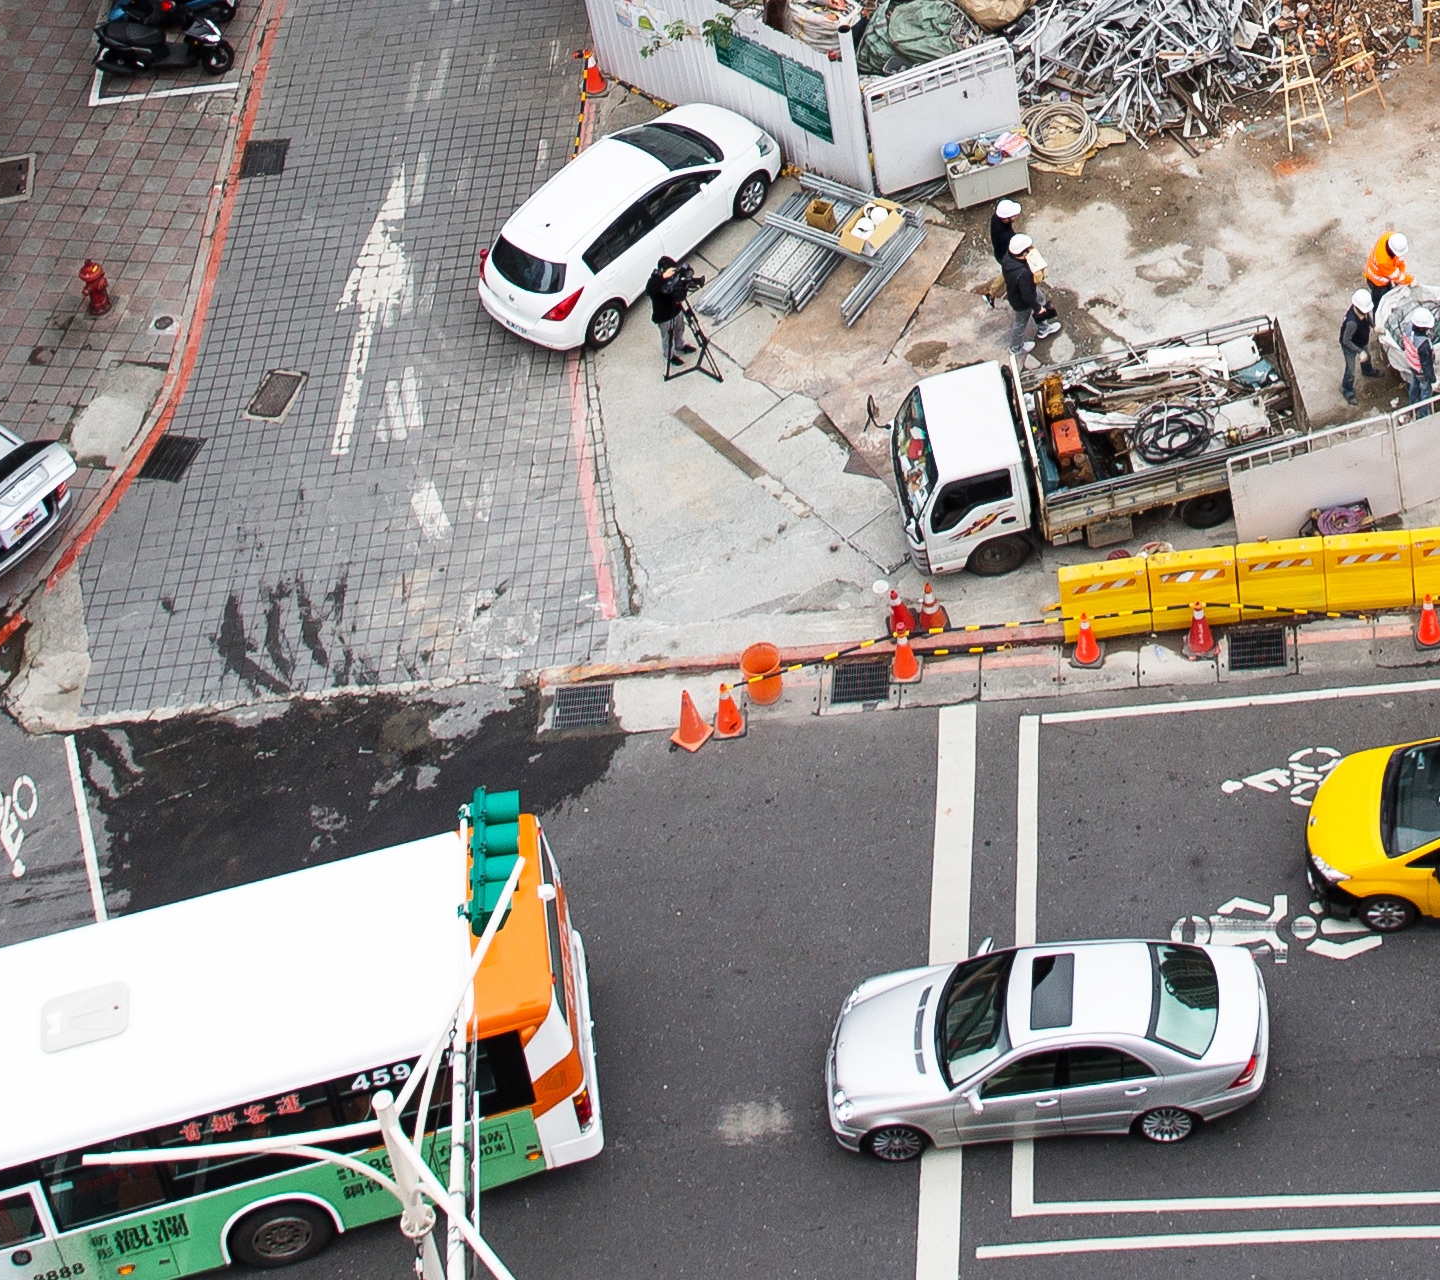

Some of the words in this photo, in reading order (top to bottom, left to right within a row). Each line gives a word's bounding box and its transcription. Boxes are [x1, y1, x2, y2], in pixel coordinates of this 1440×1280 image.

[349, 1064, 411, 1094] 459
[178, 1092, 306, 1142] 首都客運
